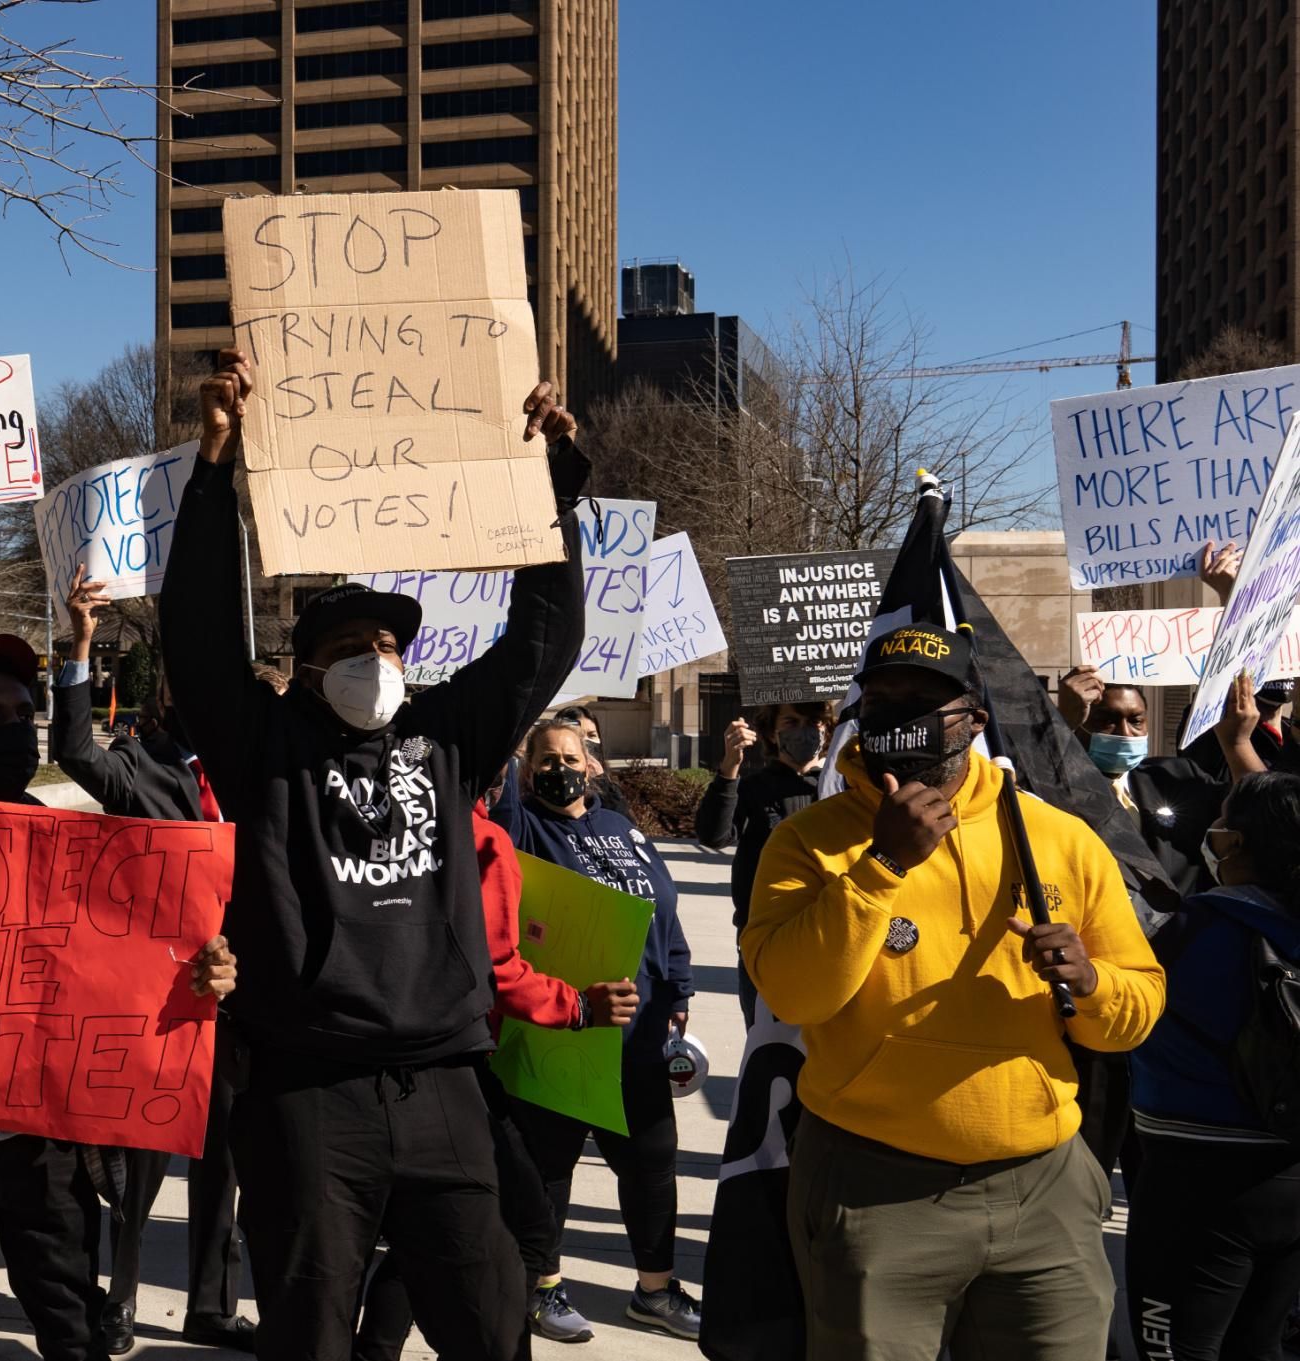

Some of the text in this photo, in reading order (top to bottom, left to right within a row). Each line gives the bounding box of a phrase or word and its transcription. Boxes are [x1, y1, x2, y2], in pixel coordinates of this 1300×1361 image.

[249, 208, 441, 292] STOP
[234, 312, 509, 366] TRYING TO
[275, 371, 482, 420] STEAL
[1068, 395, 1194, 459] THERE
[309, 436, 428, 482] OUR
[1075, 460, 1175, 509] MORE
[40, 456, 183, 575] #PROTECT
[283, 481, 458, 538] VOTES!
[102, 519, 174, 577] VOT
[580, 509, 650, 559] NDS
[1084, 517, 1162, 556] BILLS
[584, 564, 647, 613] TES!
[779, 562, 876, 584] INJUSTICE
[779, 581, 882, 604] ANYWHERE
[1078, 552, 1197, 586] SUPPRESSING
[762, 601, 872, 624] IS A THREAT
[1081, 608, 1225, 659] #PROTE
[637, 638, 698, 675] ODAY!
[772, 641, 867, 663] EVERYWH
[880, 637, 950, 660] NAACP
[1099, 652, 1161, 681] THE
[369, 820, 438, 862] BLAC
[1011, 893, 1062, 912] NCP
[1141, 1296, 1174, 1361] LEIN
